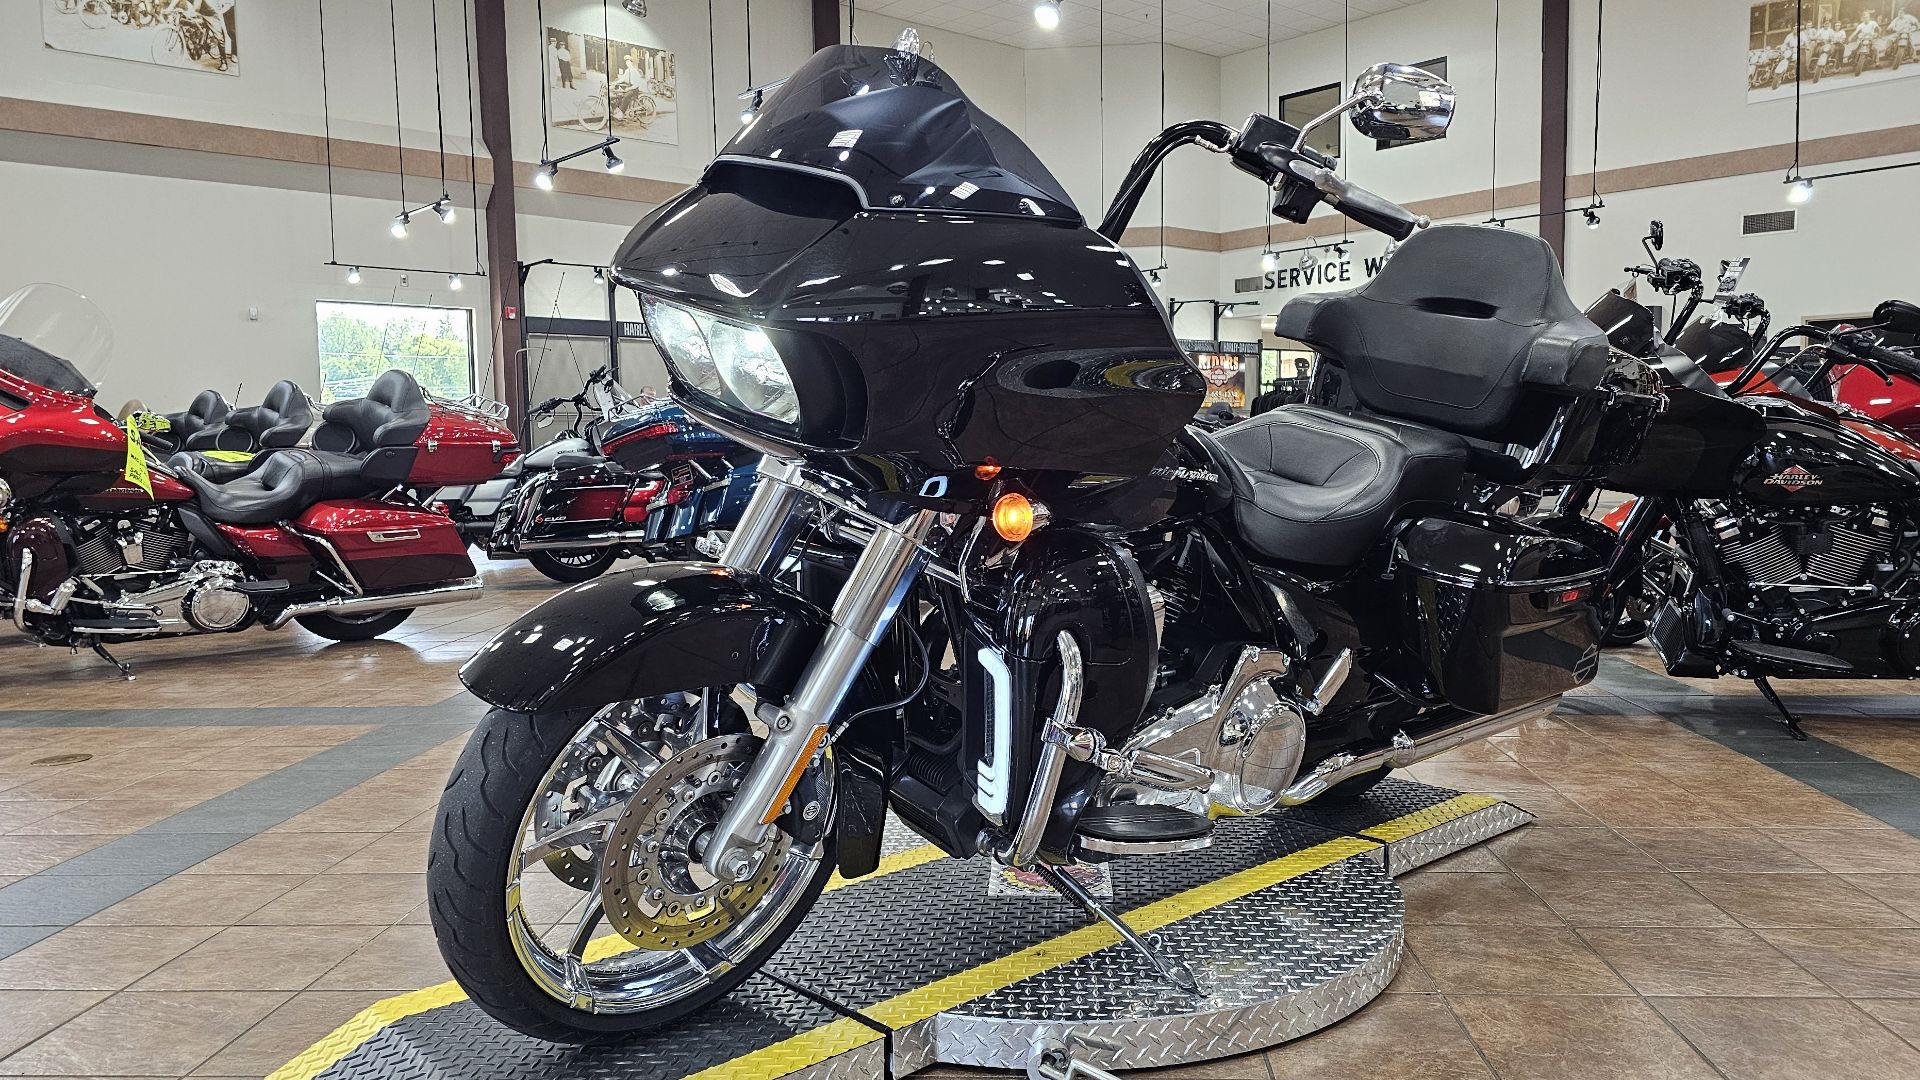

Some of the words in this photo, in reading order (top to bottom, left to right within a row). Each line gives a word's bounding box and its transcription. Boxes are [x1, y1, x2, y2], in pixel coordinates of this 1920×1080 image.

[1264, 260, 1351, 290] SERVICE
[1364, 256, 1384, 278] W
[624, 323, 650, 336] HARLE
